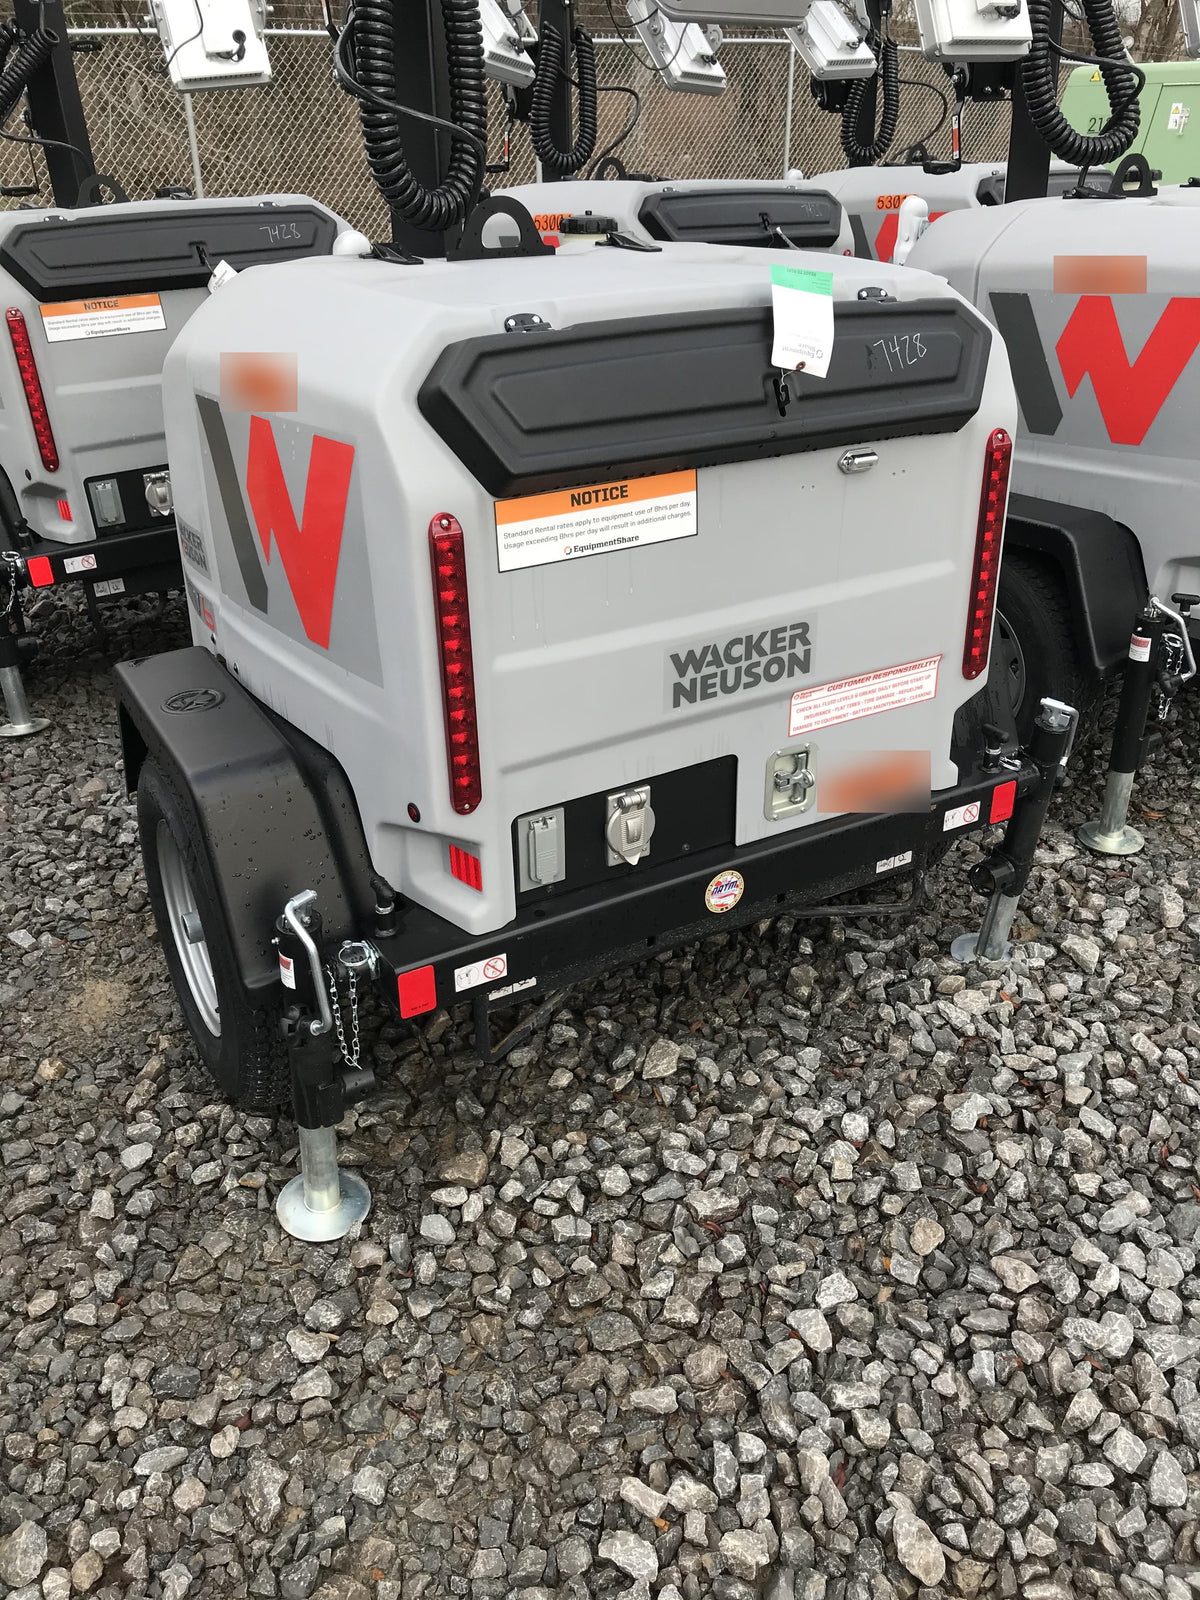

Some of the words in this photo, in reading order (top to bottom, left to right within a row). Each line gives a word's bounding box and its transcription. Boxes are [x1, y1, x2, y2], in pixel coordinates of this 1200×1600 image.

[1088, 117, 1112, 132] 21
[877, 195, 907, 210] 530
[259, 223, 301, 243] 7428
[84, 300, 119, 310] NOTICE
[873, 333, 927, 372] 7428
[570, 484, 628, 507] NOTICE
[504, 530, 534, 539] Standard
[535, 524, 555, 533] Rental
[557, 522, 573, 530] rates
[575, 519, 592, 527] apply
[601, 512, 633, 522] equipment
[504, 541, 525, 550] Usage
[526, 535, 558, 546] exceeding
[611, 522, 628, 530] result
[637, 515, 666, 525] additional
[667, 511, 691, 520] charges.
[573, 534, 639, 554] EquipmentShare
[670, 622, 811, 678] WACKER
[673, 648, 811, 708] NEUSON
[827, 676, 871, 692] CUSTOMER
[872, 659, 938, 680] RESPONSIBILITY
